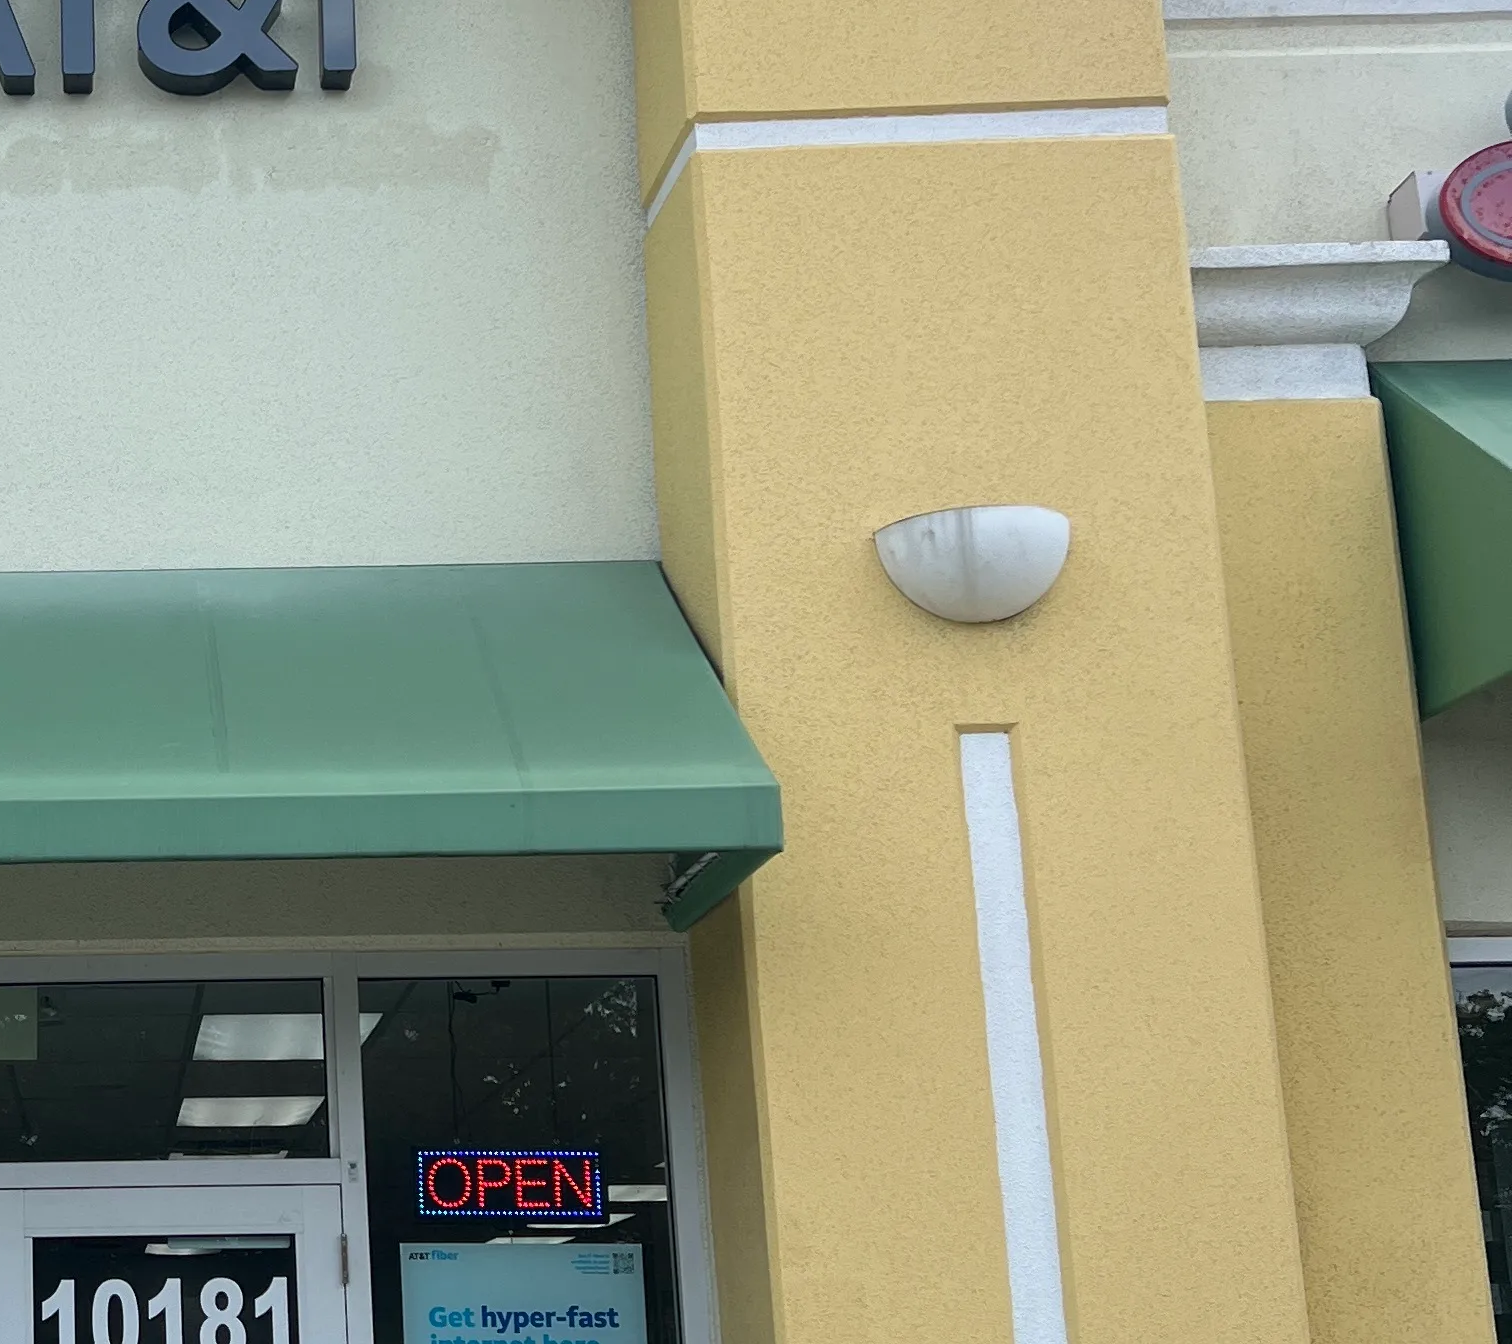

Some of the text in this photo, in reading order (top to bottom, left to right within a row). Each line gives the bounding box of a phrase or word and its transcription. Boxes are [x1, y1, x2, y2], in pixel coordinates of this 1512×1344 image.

[427, 1157, 592, 1208] OPEN
[428, 1305, 620, 1334] Get hyper-fast
